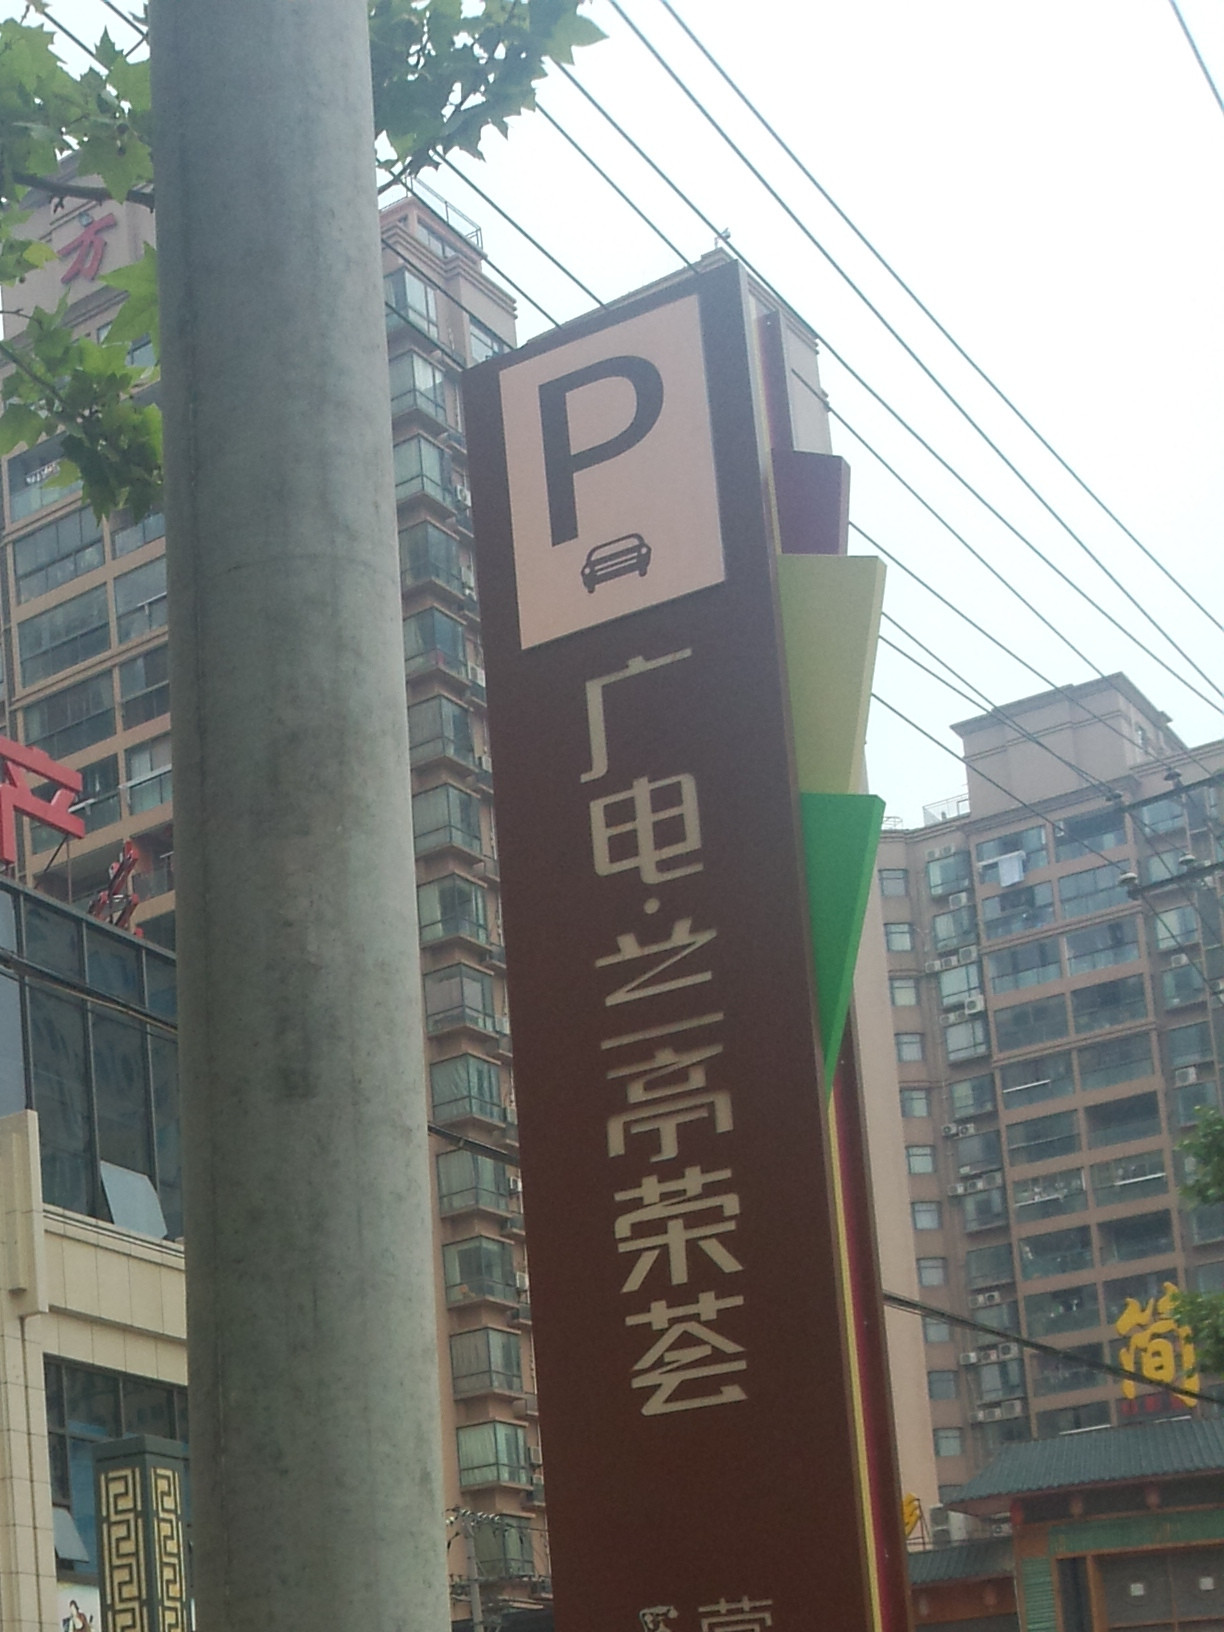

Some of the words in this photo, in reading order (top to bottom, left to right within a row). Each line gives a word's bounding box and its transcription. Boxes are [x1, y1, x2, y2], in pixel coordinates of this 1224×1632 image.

[537, 354, 665, 548] P
[580, 646, 749, 1418] 广电·兰亭荣荟
